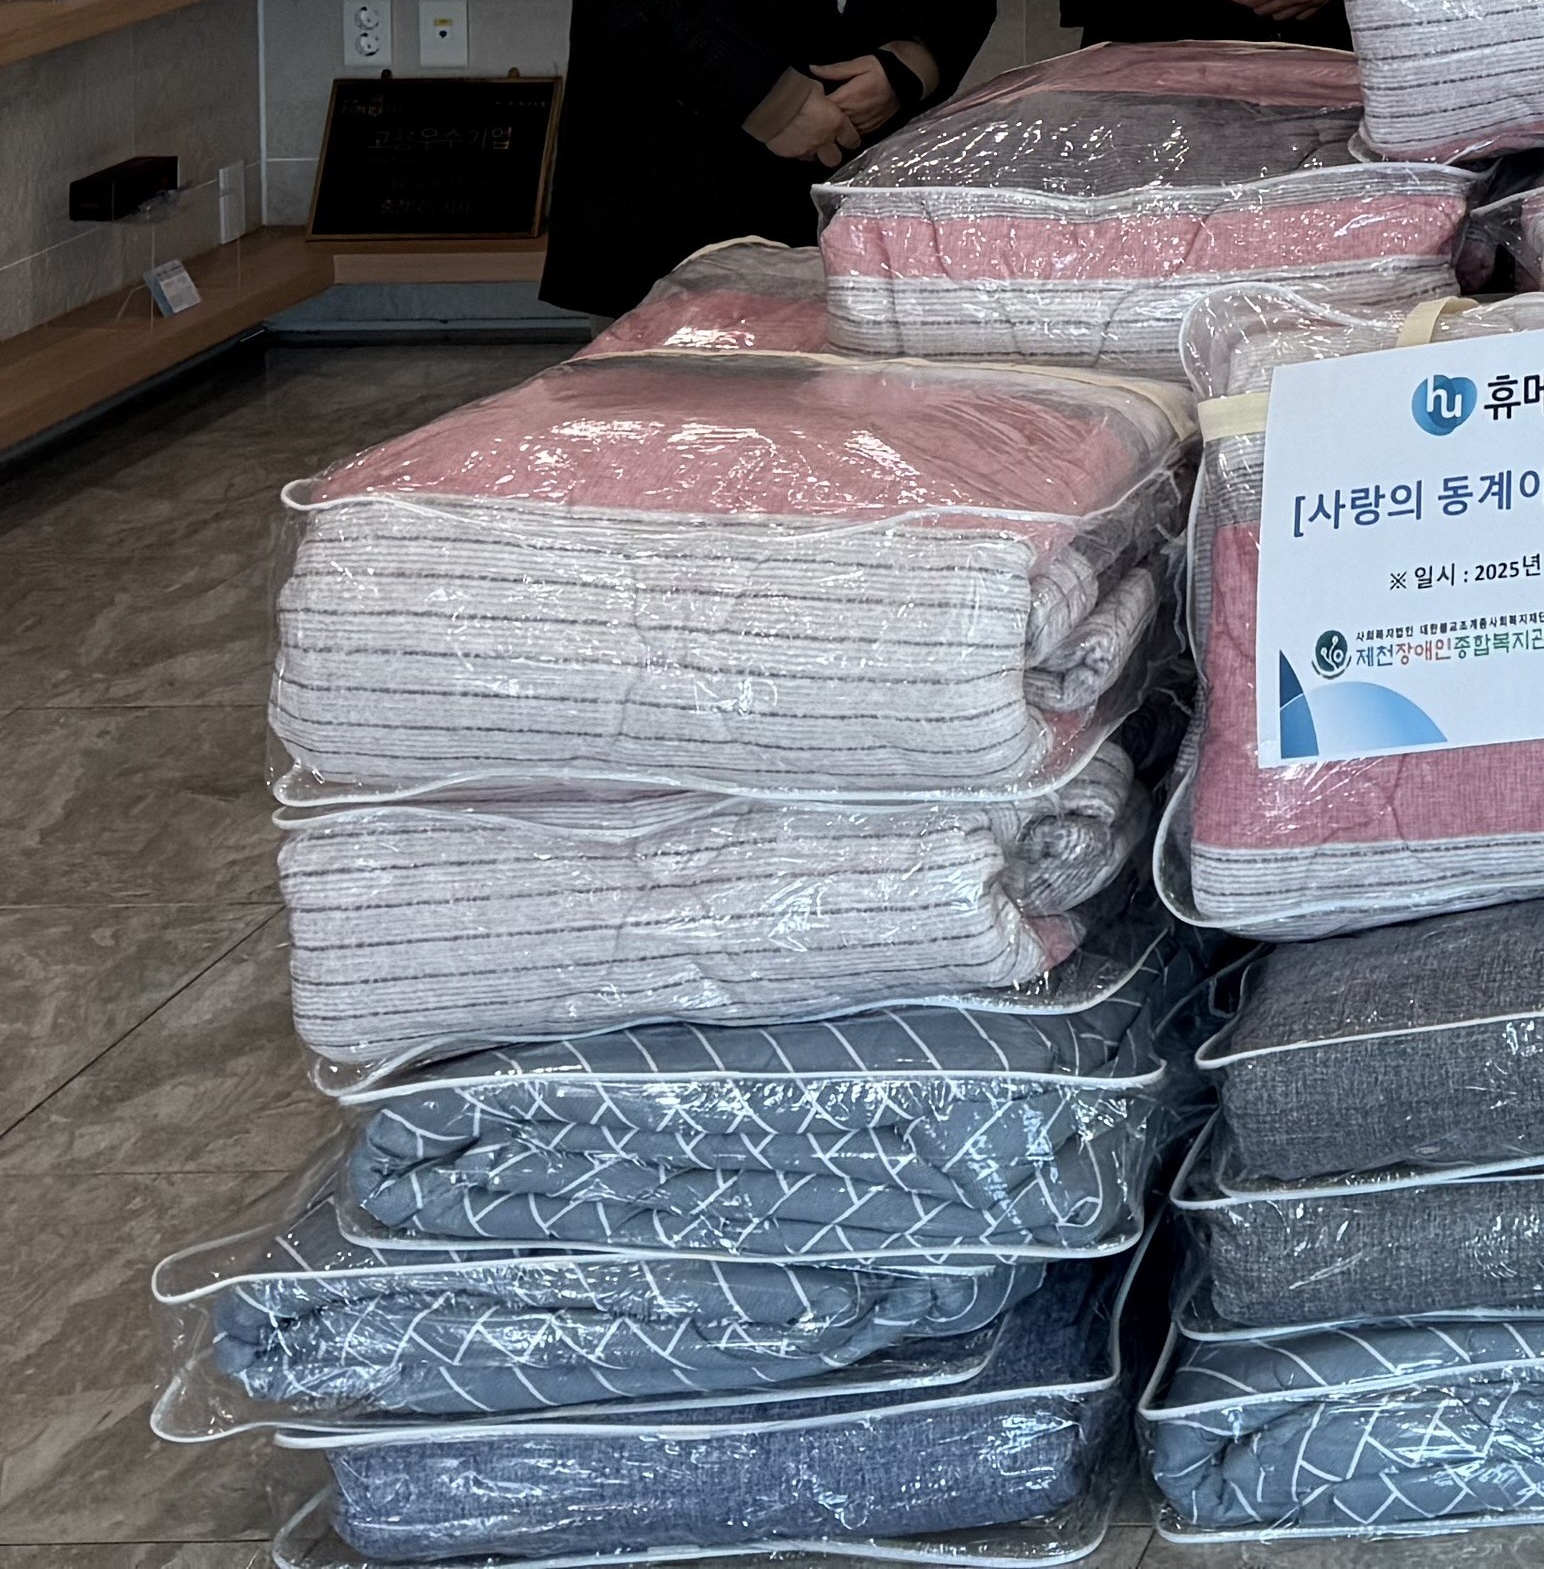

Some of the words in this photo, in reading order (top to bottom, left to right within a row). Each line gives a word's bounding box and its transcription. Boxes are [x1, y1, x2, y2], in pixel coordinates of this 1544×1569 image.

[1294, 480, 1422, 537] [사랑의
[1415, 563, 1454, 589] 일시
[1475, 554, 1540, 581] 2025년
